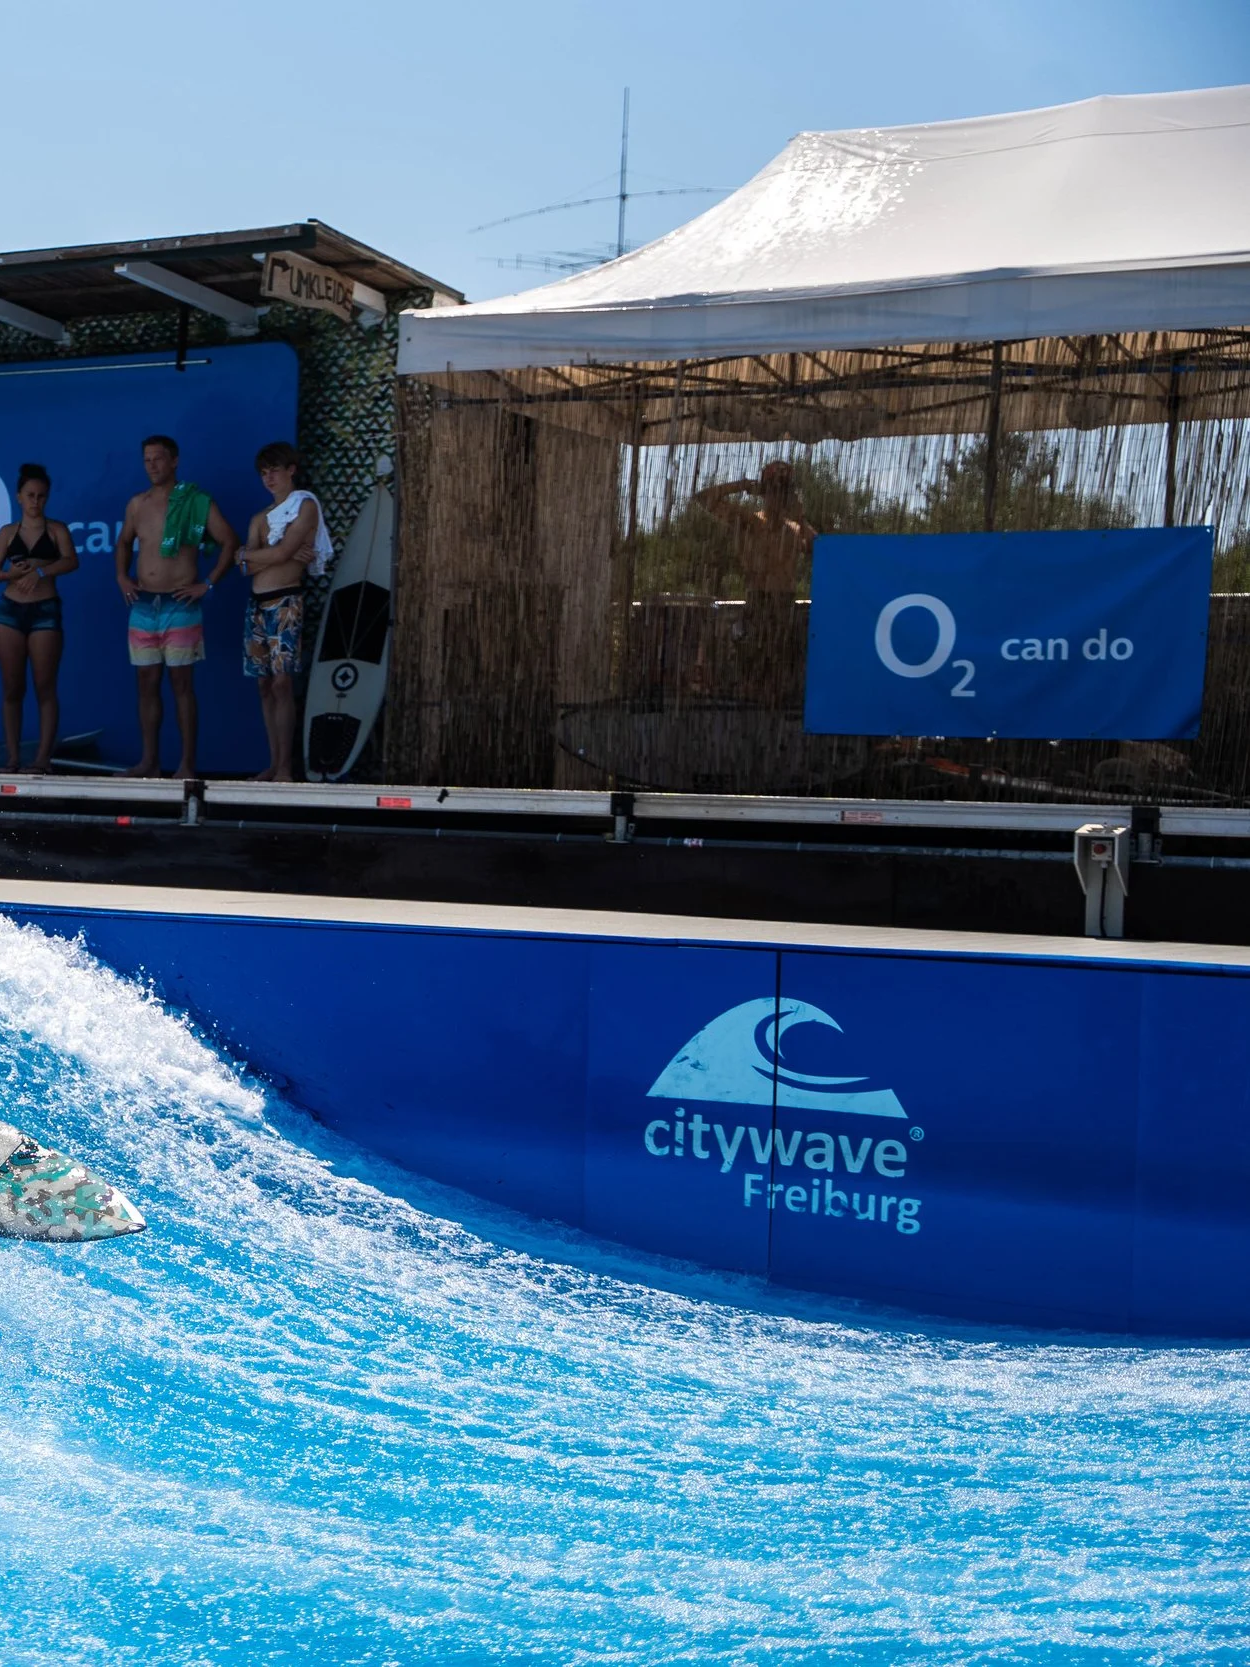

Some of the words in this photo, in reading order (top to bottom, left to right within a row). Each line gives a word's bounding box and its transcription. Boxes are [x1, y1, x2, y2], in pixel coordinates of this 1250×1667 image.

[67, 521, 140, 553] ca
[875, 593, 976, 697] O2
[1000, 637, 1069, 661] can
[1082, 629, 1134, 661] do
[743, 1173, 922, 1234] Freiburg
